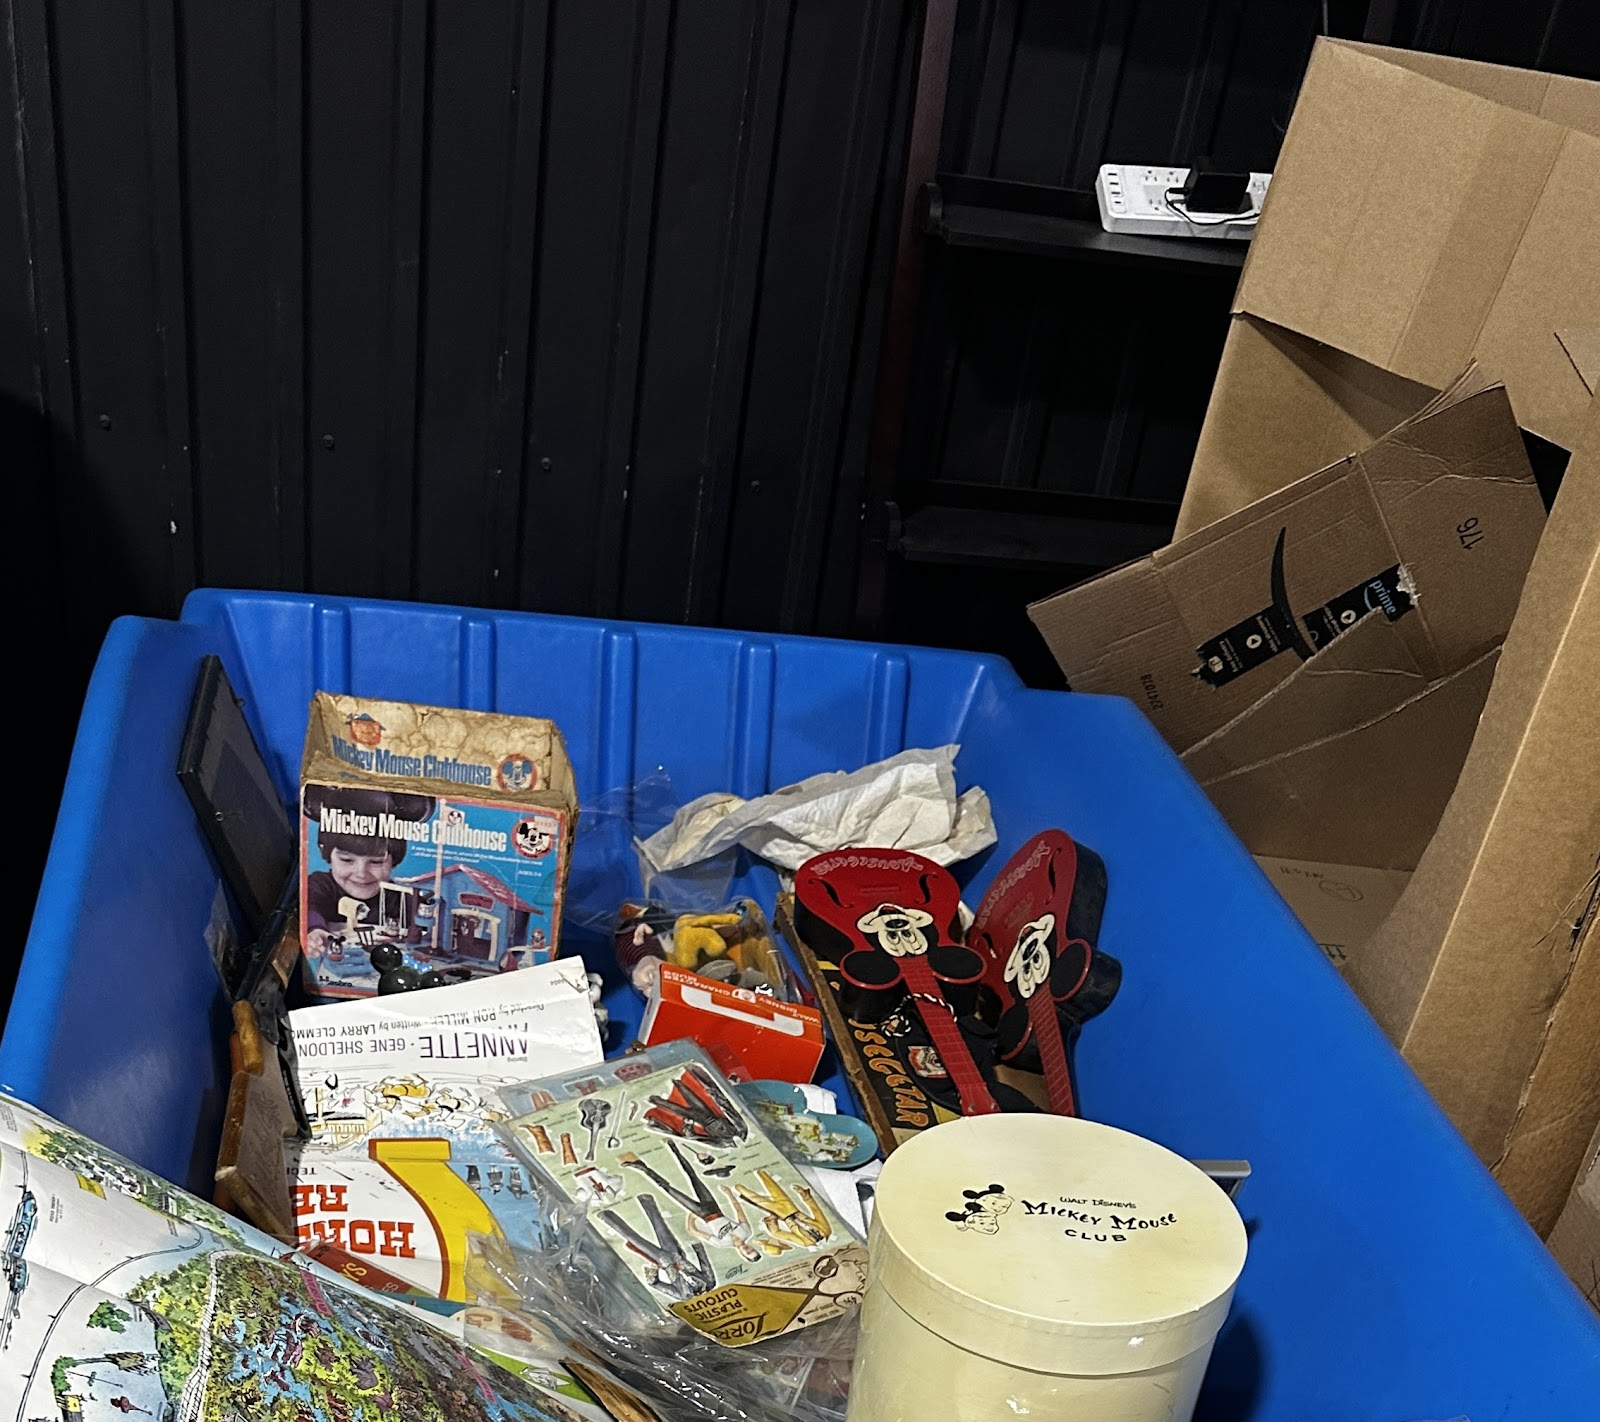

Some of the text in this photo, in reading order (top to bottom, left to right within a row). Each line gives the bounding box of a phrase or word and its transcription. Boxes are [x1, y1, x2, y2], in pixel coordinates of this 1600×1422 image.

[1457, 517, 1484, 550] 176
[1367, 577, 1399, 617] prime
[332, 735, 492, 786] Mickey Mouse Clubhouse
[320, 807, 377, 838] Mickey
[378, 812, 430, 843] Mouse
[432, 817, 508, 852] Clubhouse
[340, 1022, 375, 1037] LARRY
[378, 1020, 389, 1031] by
[390, 1017, 421, 1031] Written
[297, 1036, 363, 1060] SHELDON
[368, 1035, 406, 1054] GENE
[416, 1023, 529, 1066] ANNETTE
[1064, 1229, 1127, 1242] CLUB
[682, 1286, 738, 1315] CUTOUTS
[694, 1297, 742, 1322] PLASTIC
